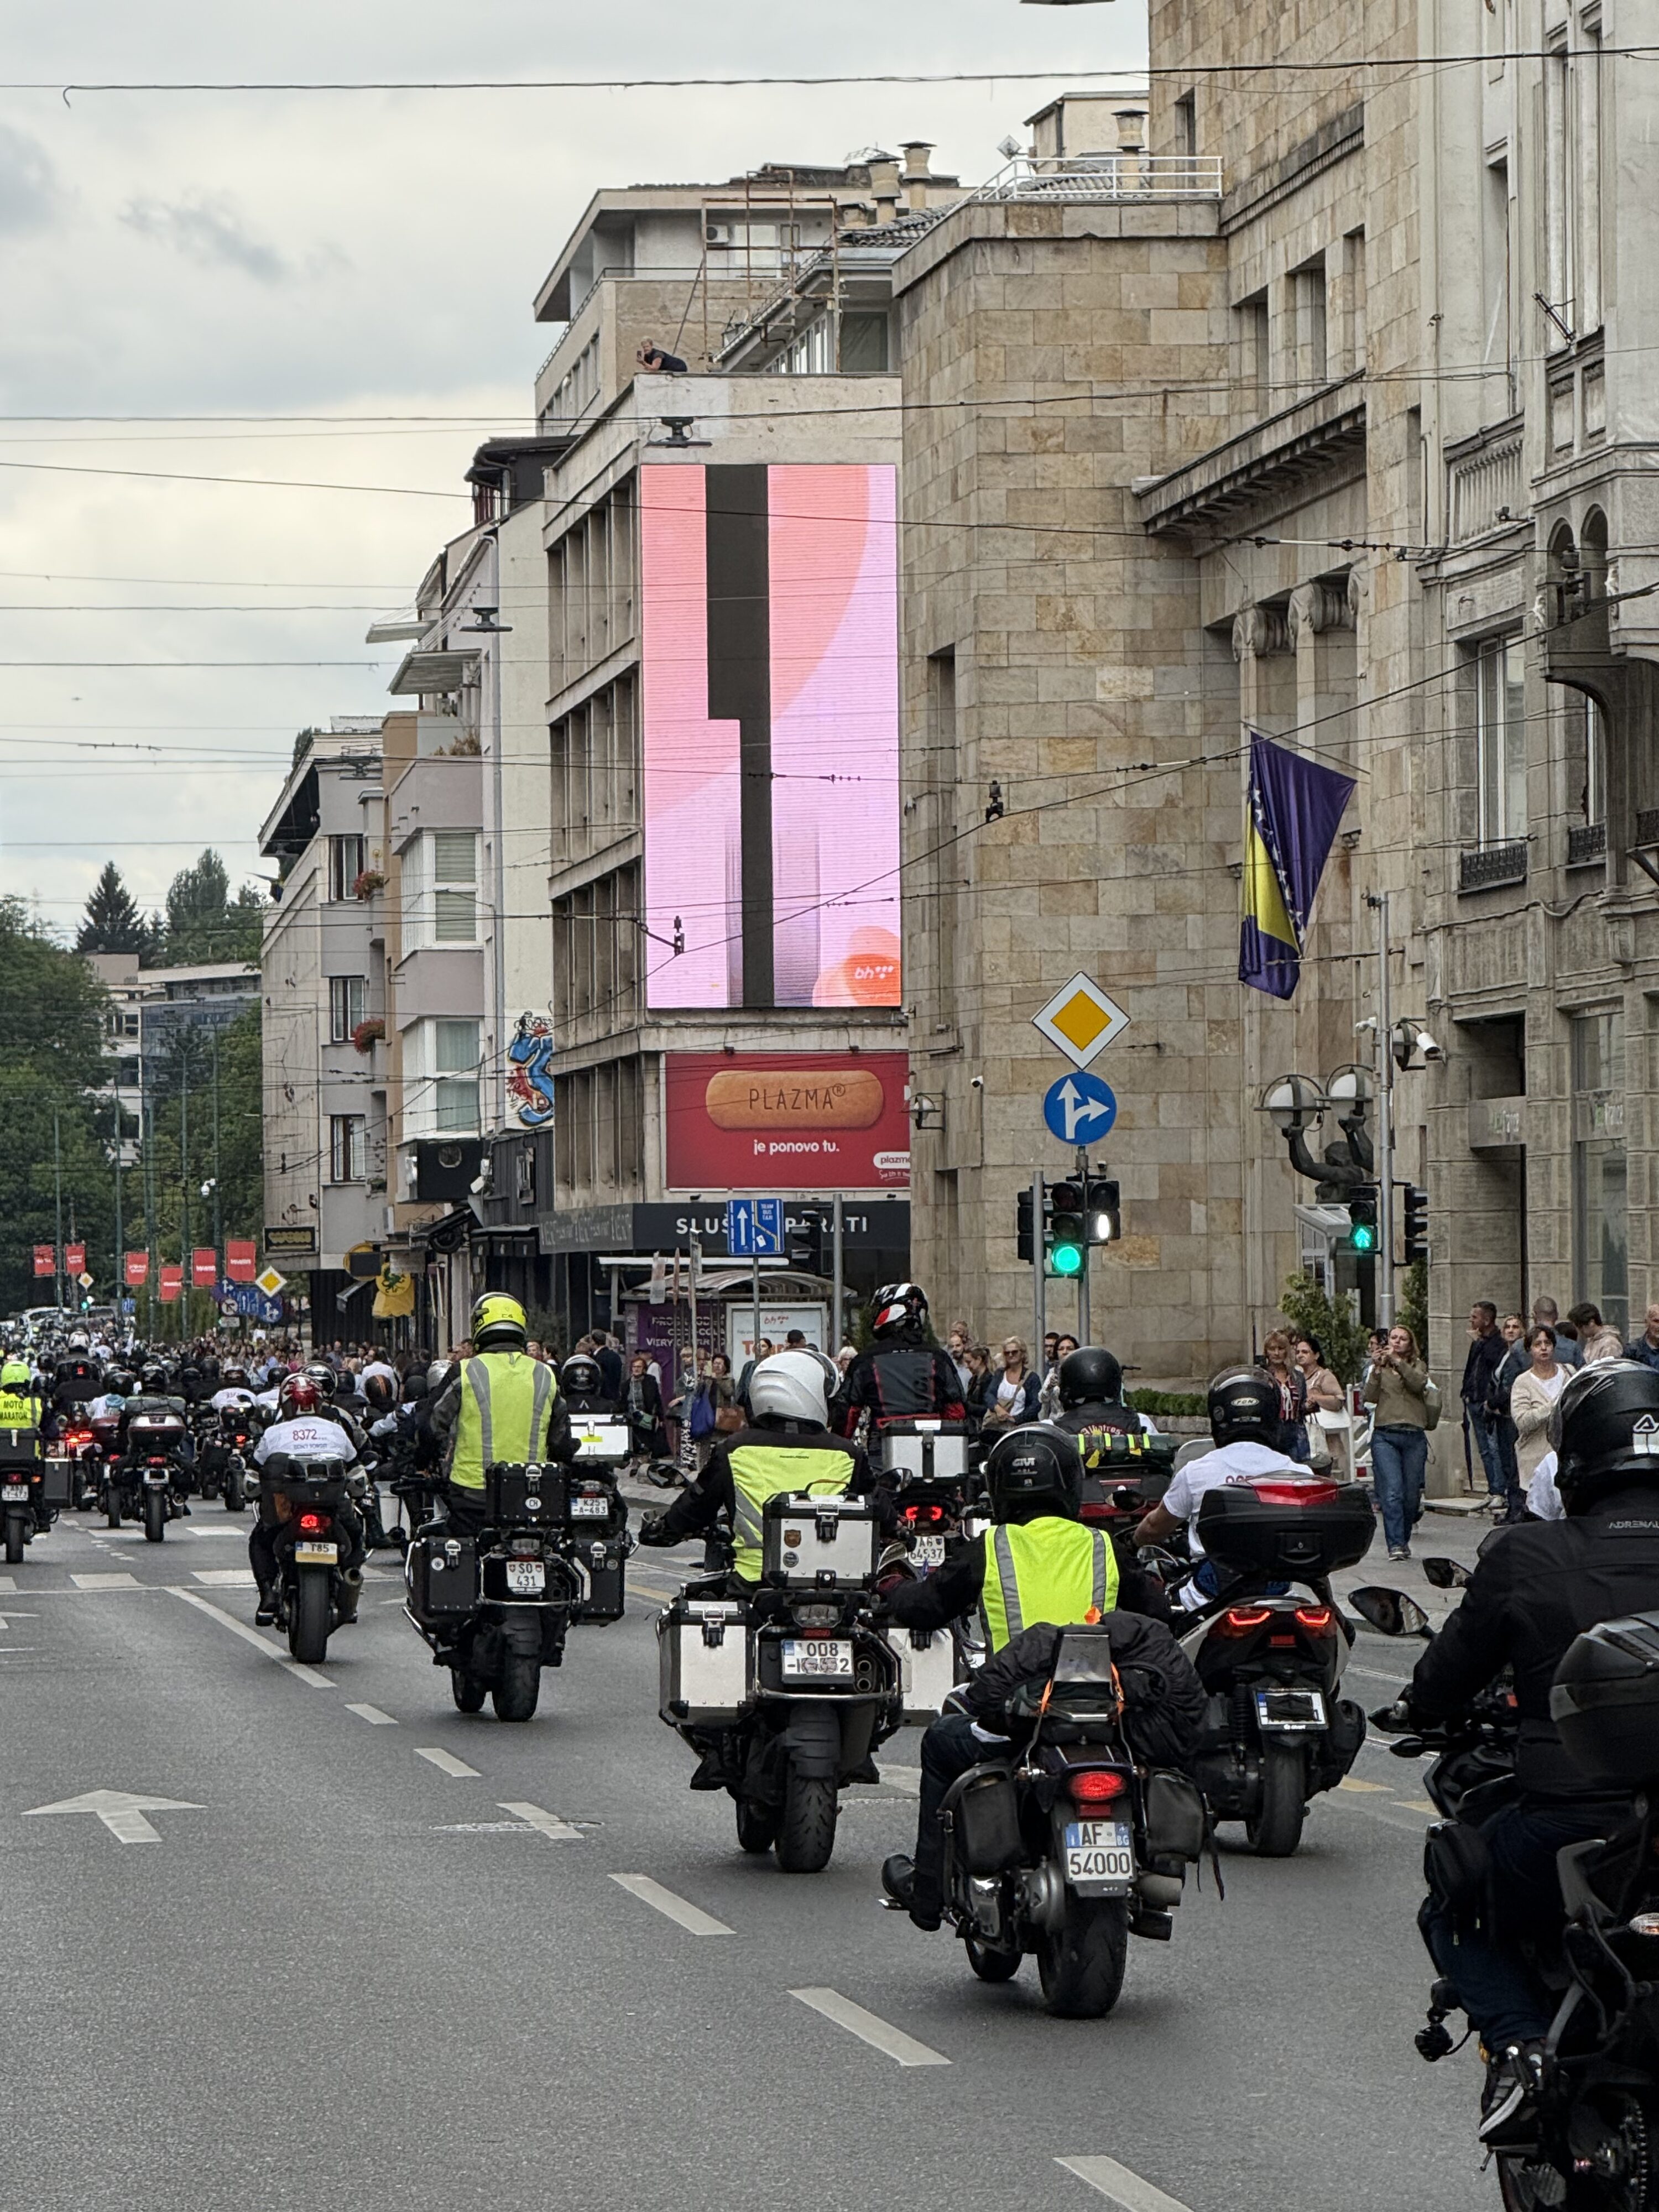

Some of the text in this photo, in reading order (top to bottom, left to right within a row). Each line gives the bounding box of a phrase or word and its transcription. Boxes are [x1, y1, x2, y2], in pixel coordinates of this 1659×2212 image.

[753, 1139, 840, 1155] je ponovo tu.
[3, 1400, 23, 1410] MOTO
[517, 1575, 536, 1587] 431
[1082, 1823, 1103, 1845] AF
[1117, 1835, 1129, 1846] BG
[1070, 1852, 1130, 1875] 54000
